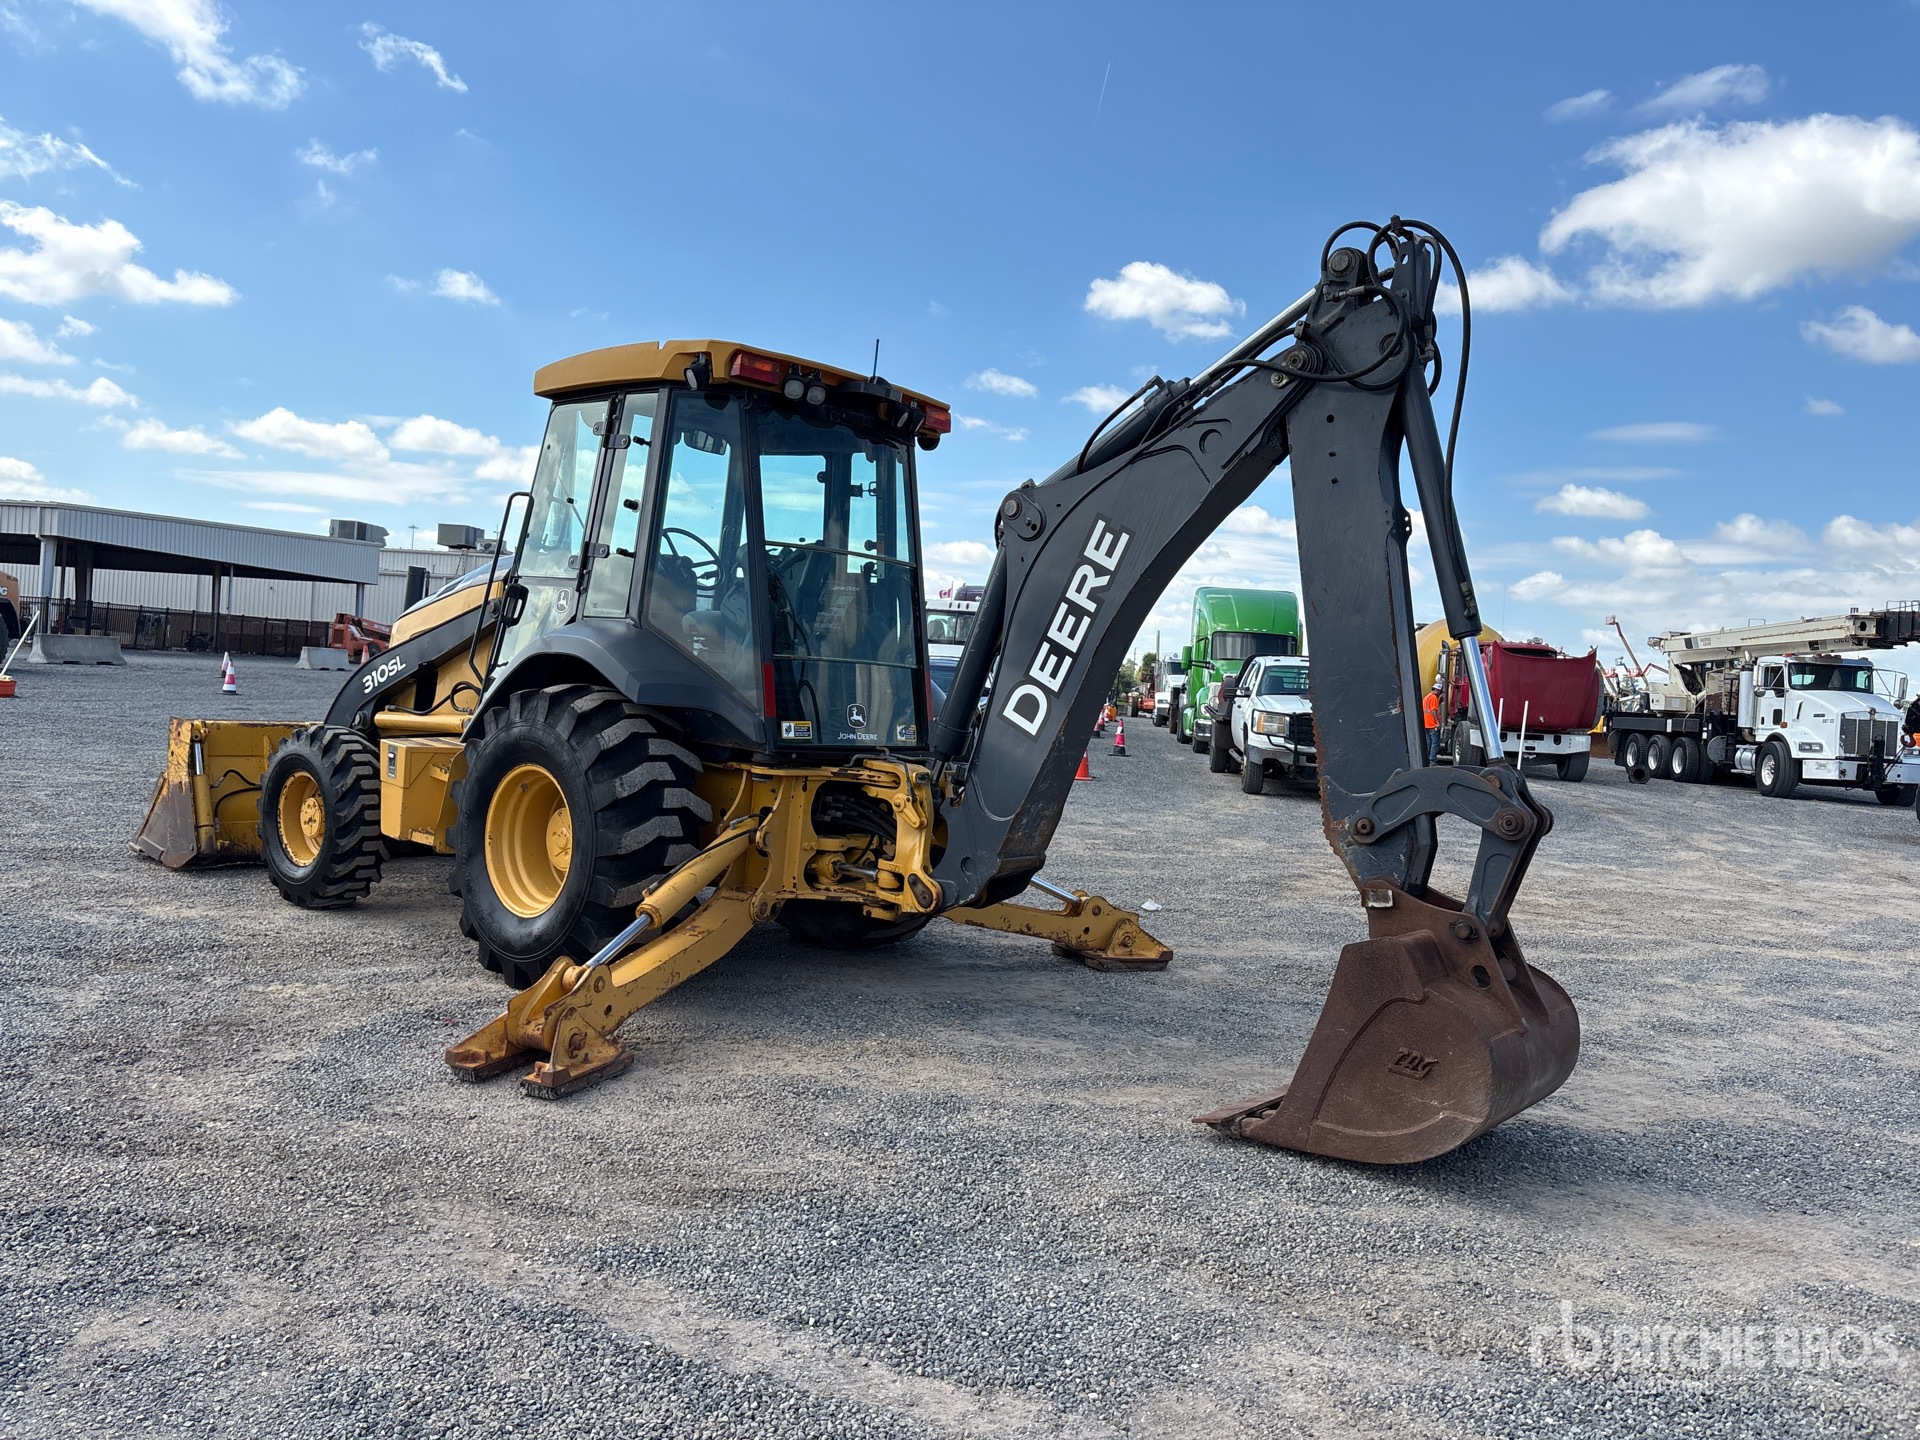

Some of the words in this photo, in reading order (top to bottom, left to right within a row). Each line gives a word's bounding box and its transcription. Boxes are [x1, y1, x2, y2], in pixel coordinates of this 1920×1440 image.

[1002, 518, 1131, 737] DEERE
[362, 655, 407, 694] 310SL
[838, 732, 856, 740] JOHN
[857, 732, 878, 740] DEERE
